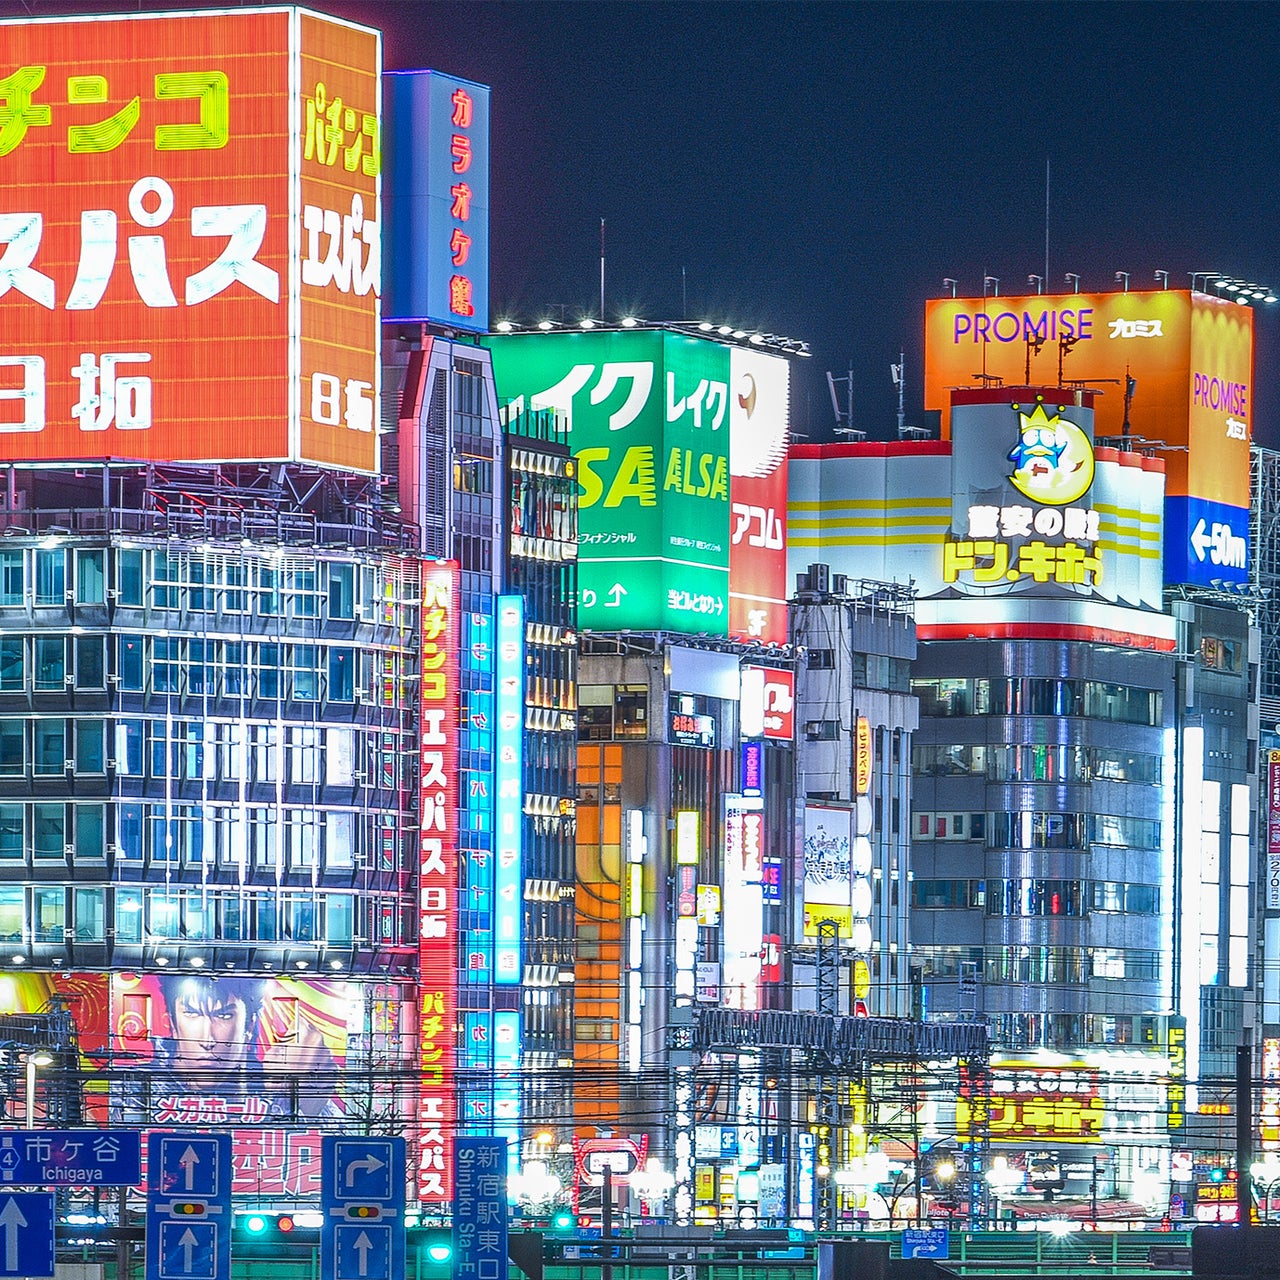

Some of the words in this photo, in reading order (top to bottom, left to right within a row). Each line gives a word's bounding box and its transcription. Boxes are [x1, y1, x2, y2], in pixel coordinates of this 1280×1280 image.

[303, 82, 381, 177] パチンコ
[302, 192, 382, 299] エスパス
[954, 308, 1095, 344] PROMISE
[1108, 318, 1163, 340] プロミス
[666, 371, 728, 431] レイク
[1193, 372, 1248, 418] PROMISE
[664, 446, 728, 502] ALSA
[732, 502, 784, 551] アコム
[422, 580, 447, 700] パチンコ
[421, 708, 448, 876] エスパス
[155, 1095, 272, 1124] メガホール
[3, 1152, 14, 1165] 4
[42, 1167, 103, 1184] Ichigaya
[457, 1148, 475, 1222] Shinjuku
[476, 1145, 500, 1280] 新宿駅東口
